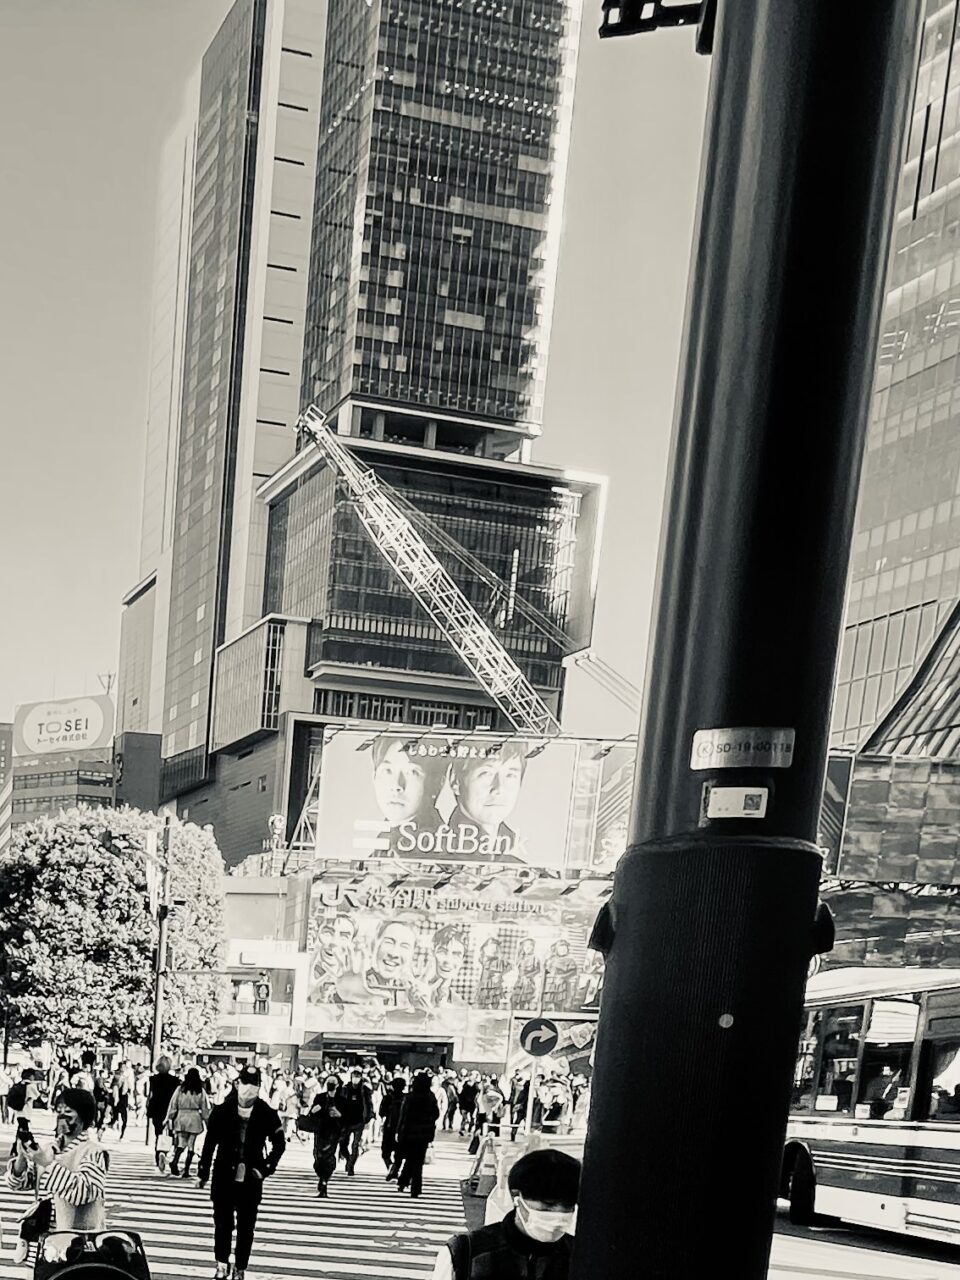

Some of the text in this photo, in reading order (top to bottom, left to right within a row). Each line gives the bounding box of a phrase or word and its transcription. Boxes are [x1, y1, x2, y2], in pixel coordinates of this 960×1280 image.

[37, 717, 89, 735] TOSEI
[397, 820, 529, 855] SoftBank
[320, 883, 360, 909] JR
[365, 885, 436, 910] 渋谷駅
[496, 899, 545, 914] station
